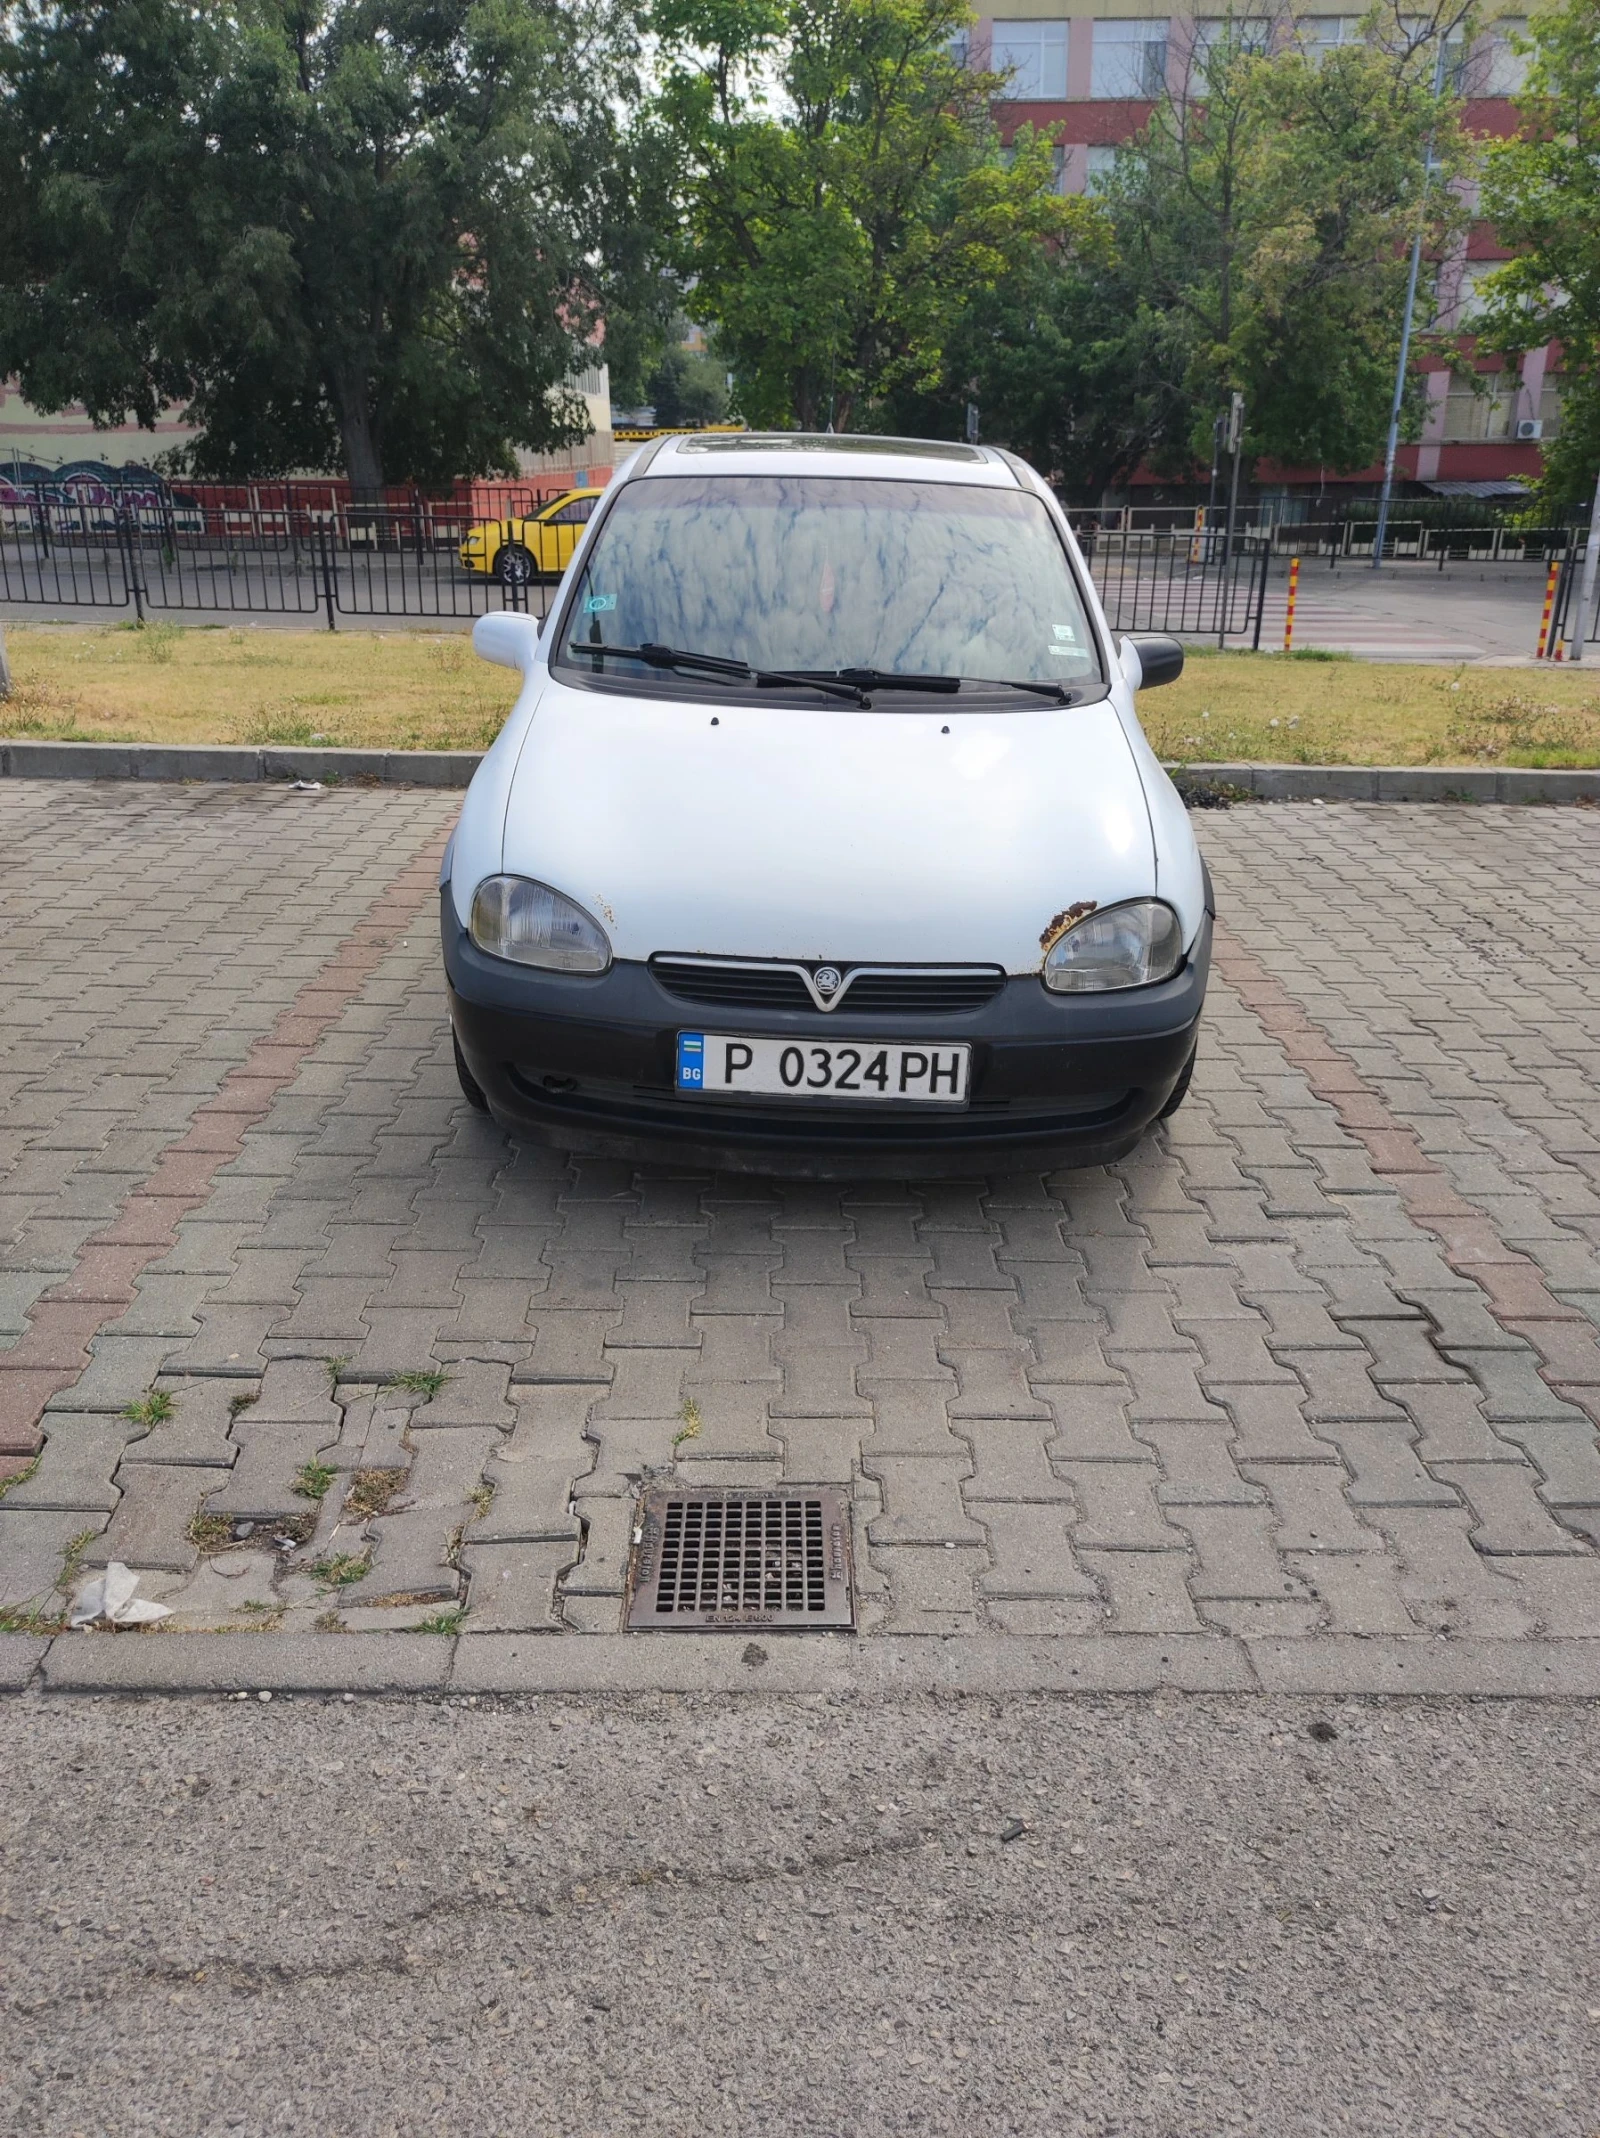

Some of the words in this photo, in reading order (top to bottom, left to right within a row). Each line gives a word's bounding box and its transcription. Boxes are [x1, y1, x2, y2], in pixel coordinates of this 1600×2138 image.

[683, 1067, 701, 1080] BG
[705, 1614, 721, 1623] EN
[723, 1614, 742, 1623] 124
